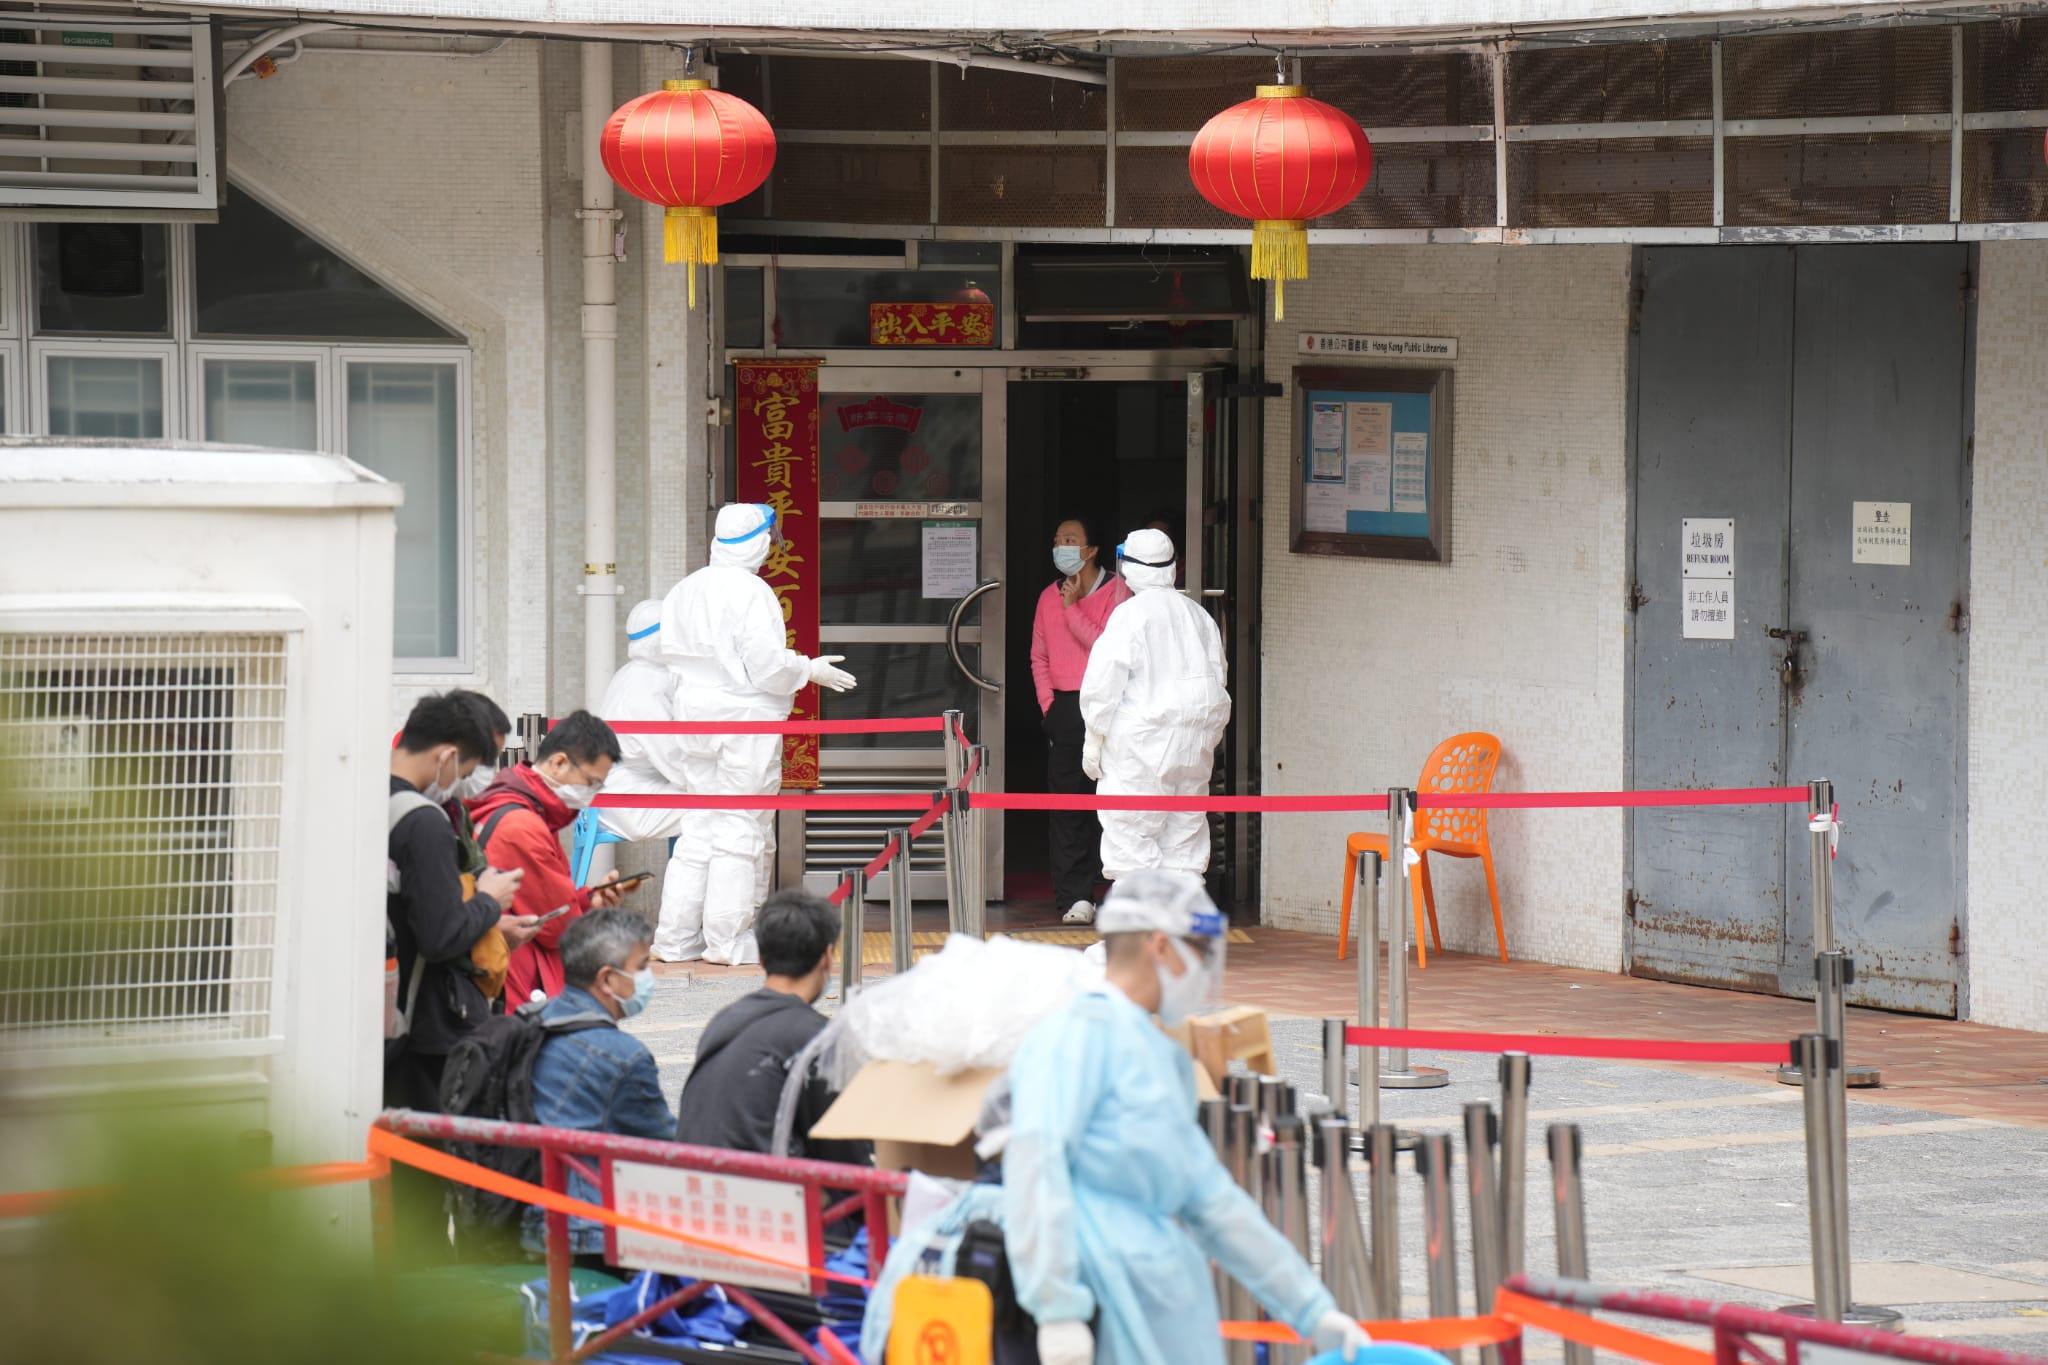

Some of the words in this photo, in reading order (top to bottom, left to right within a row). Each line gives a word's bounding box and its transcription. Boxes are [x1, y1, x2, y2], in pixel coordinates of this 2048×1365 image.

[879, 311, 985, 336] 出入平安
[1373, 339, 1388, 353] Hong
[1389, 341, 1403, 354] Kong
[1404, 341, 1422, 353] Public
[1423, 343, 1448, 353] Libraries
[1691, 532, 1724, 549] 垃圾房
[1686, 553, 1709, 564] REFUSE
[1710, 553, 1729, 565] ROOM
[1688, 590, 1729, 605] 非工作人員
